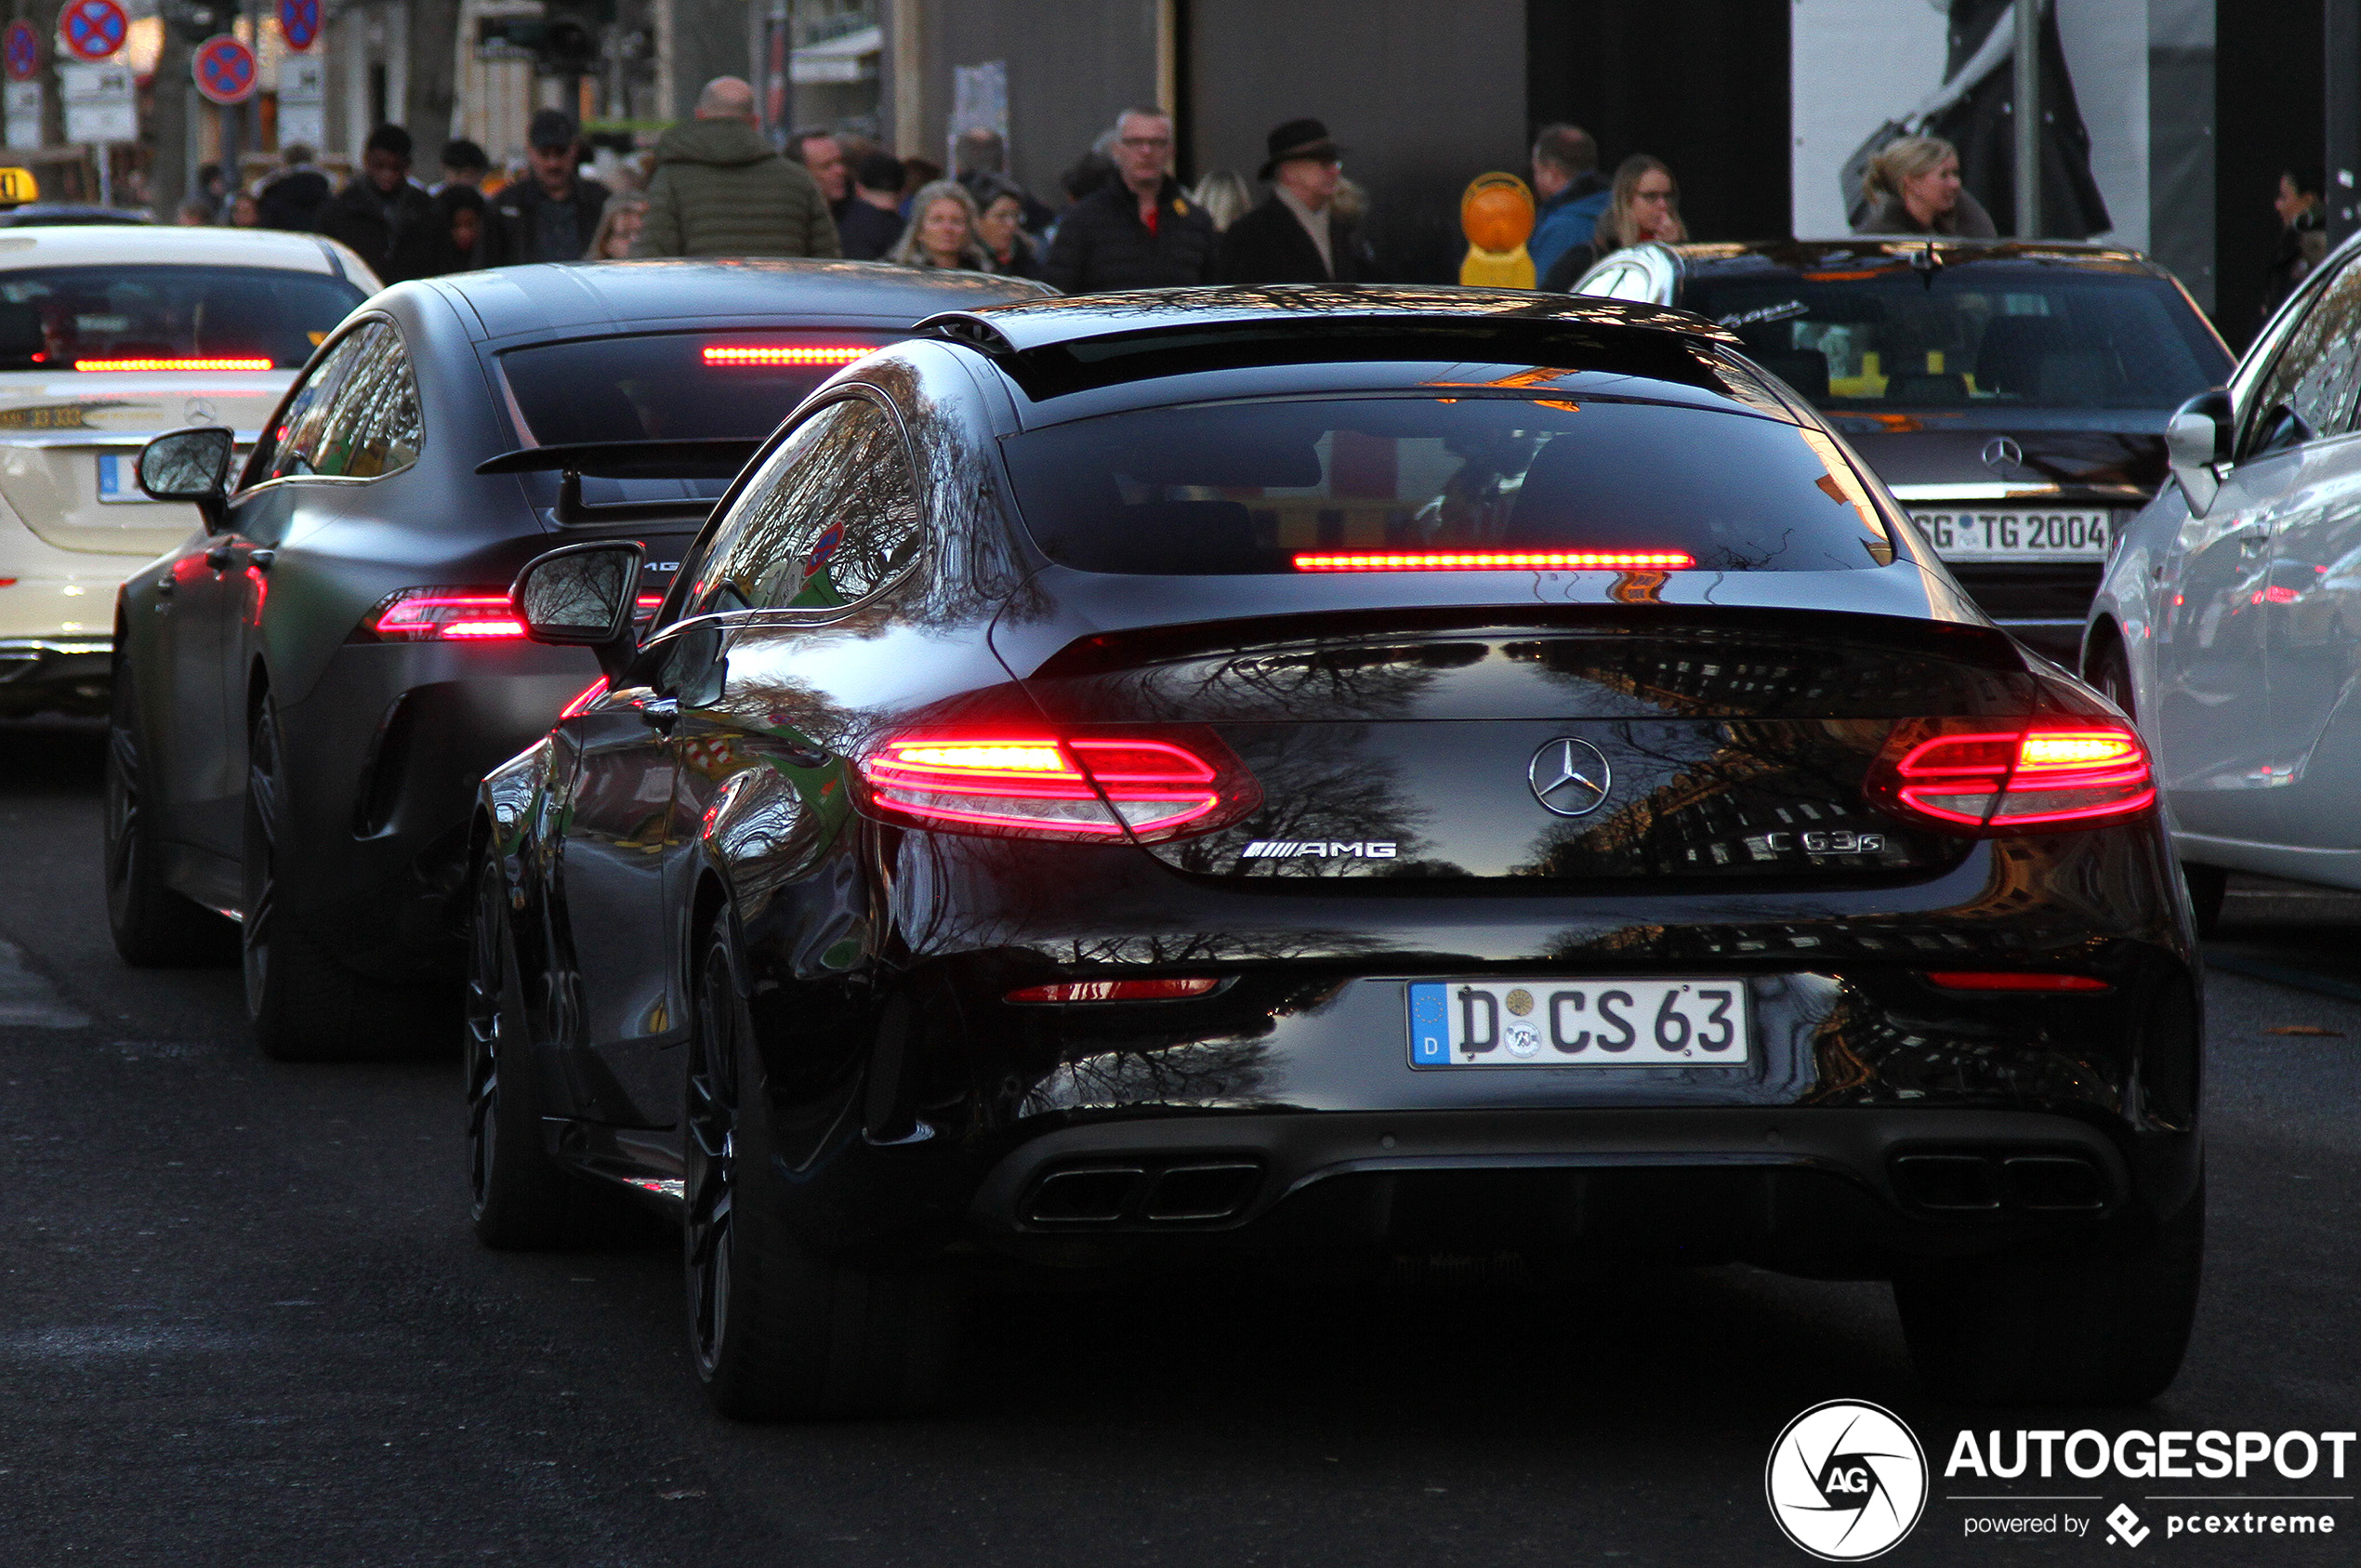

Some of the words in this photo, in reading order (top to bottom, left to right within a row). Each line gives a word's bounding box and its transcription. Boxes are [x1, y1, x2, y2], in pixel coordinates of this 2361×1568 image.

[1979, 515, 2019, 548] TG
[2026, 516, 2104, 548] 2004
[1294, 841, 1397, 858] AMG
[1457, 990, 1499, 1054] D
[1549, 990, 1636, 1054] CS
[1655, 989, 1734, 1053] 63
[1424, 1037, 1438, 1055] D
